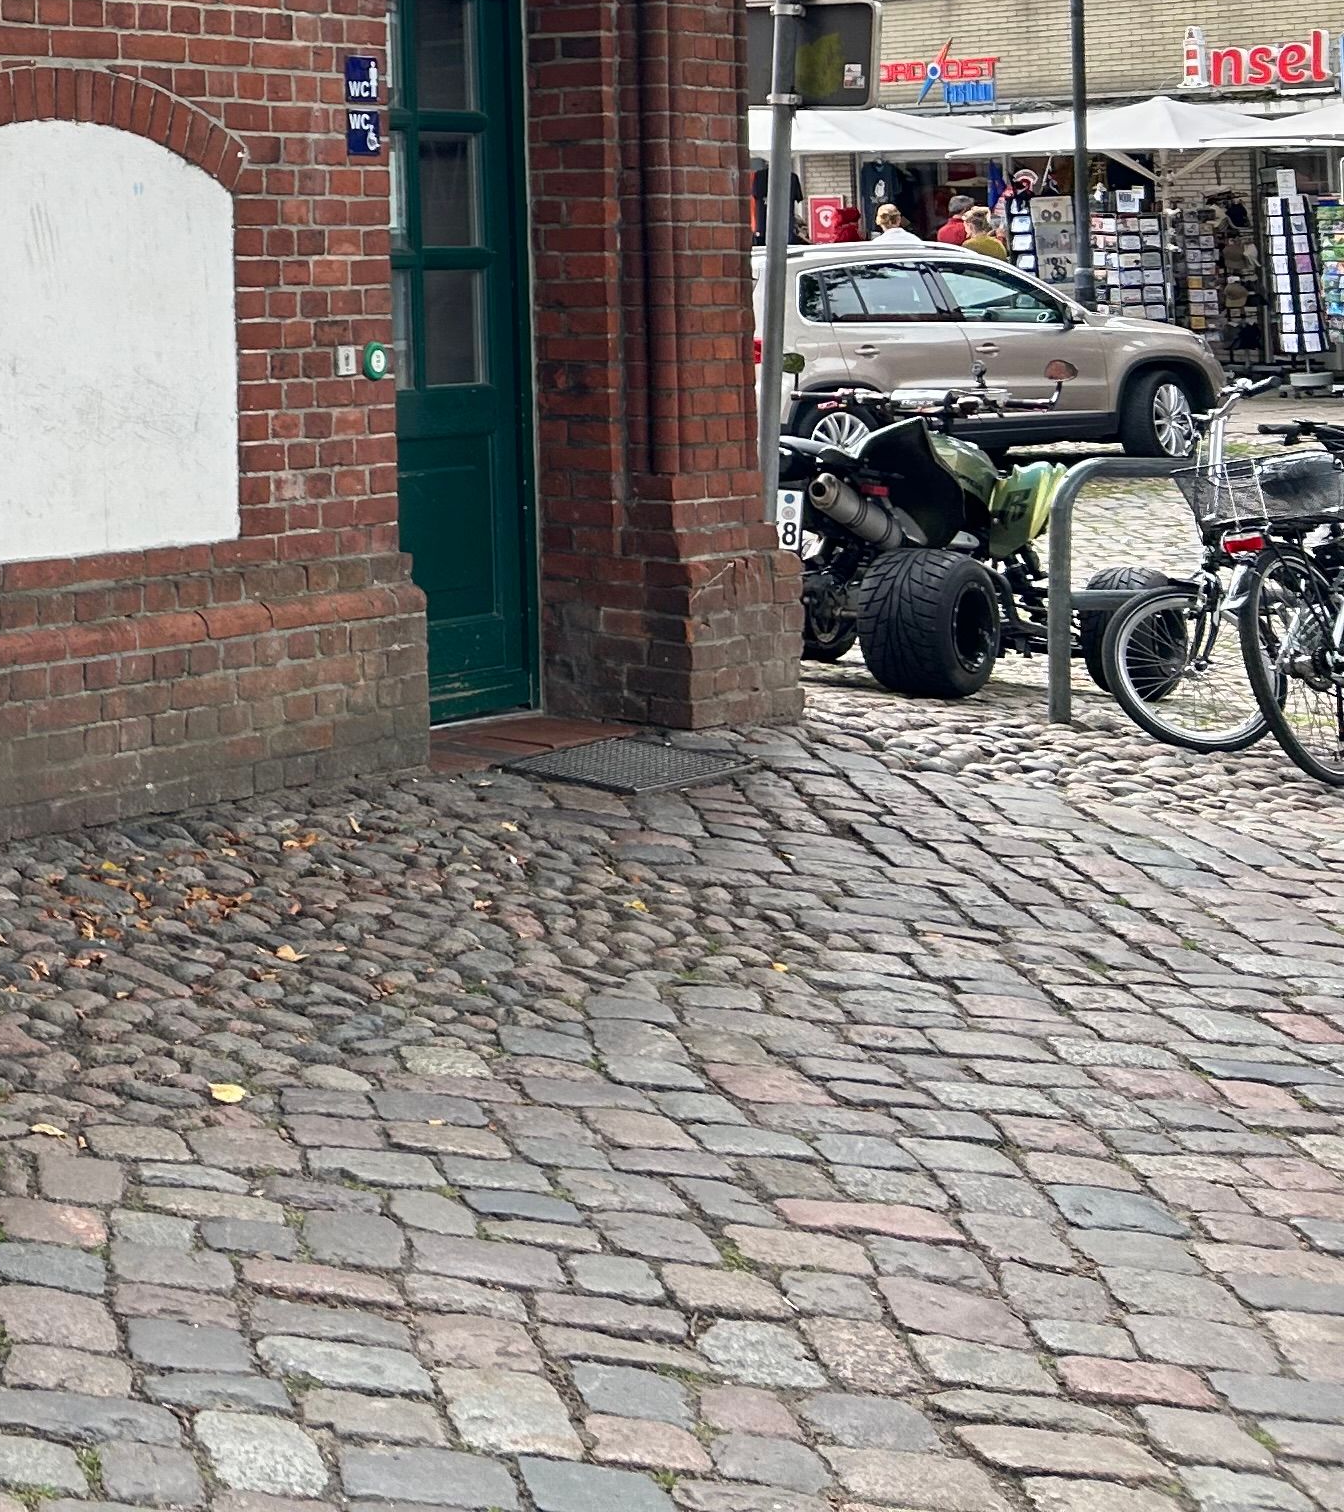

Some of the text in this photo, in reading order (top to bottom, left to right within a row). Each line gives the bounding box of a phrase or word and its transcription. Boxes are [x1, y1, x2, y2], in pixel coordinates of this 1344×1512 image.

[349, 80, 370, 98] WC
[349, 113, 371, 130] WC
[782, 521, 797, 546] 8
